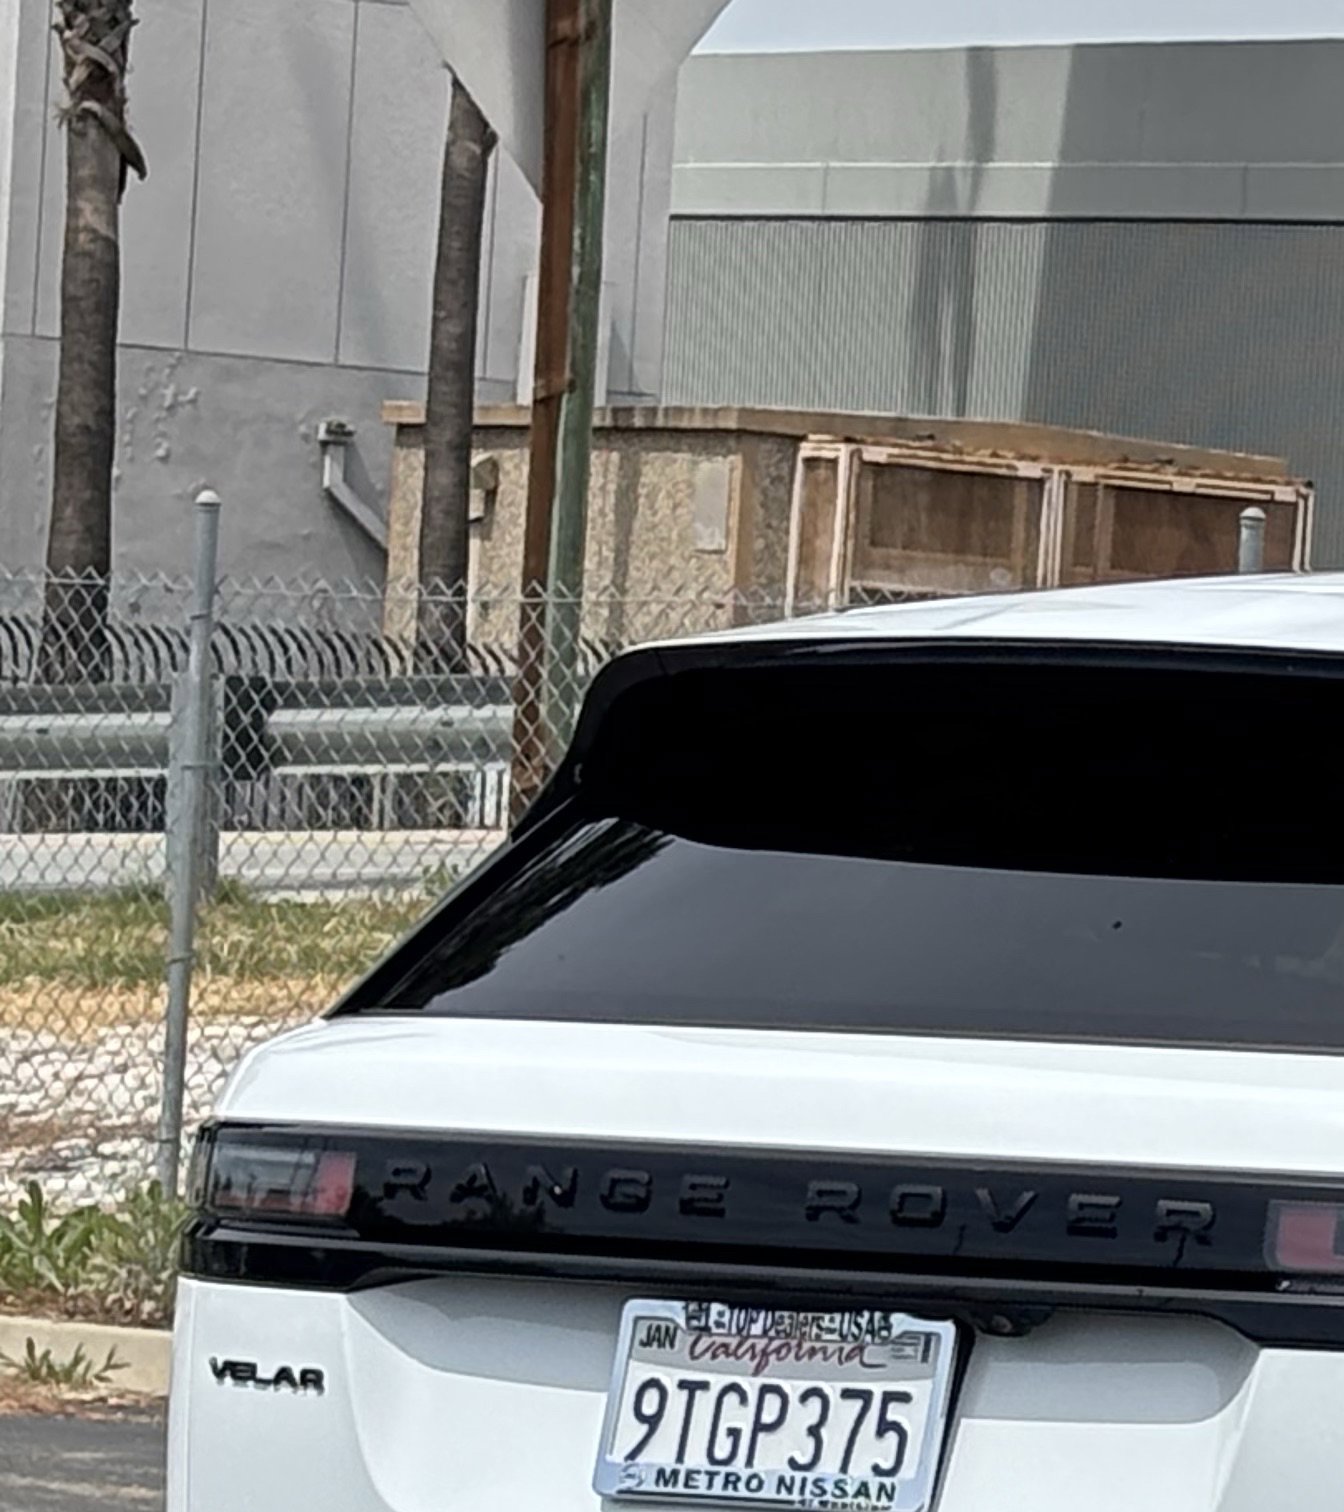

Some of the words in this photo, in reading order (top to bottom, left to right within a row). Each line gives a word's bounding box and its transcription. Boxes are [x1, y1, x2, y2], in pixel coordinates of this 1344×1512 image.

[383, 1157, 732, 1219] RANGE
[802, 1179, 1217, 1246] ROVER
[639, 1323, 678, 1350] JAN
[209, 1356, 324, 1396] VELAR
[688, 1337, 888, 1377] California
[624, 1377, 913, 1477] 9TGP375
[654, 1468, 764, 1494] METRO
[775, 1476, 896, 1503] NISSAN
